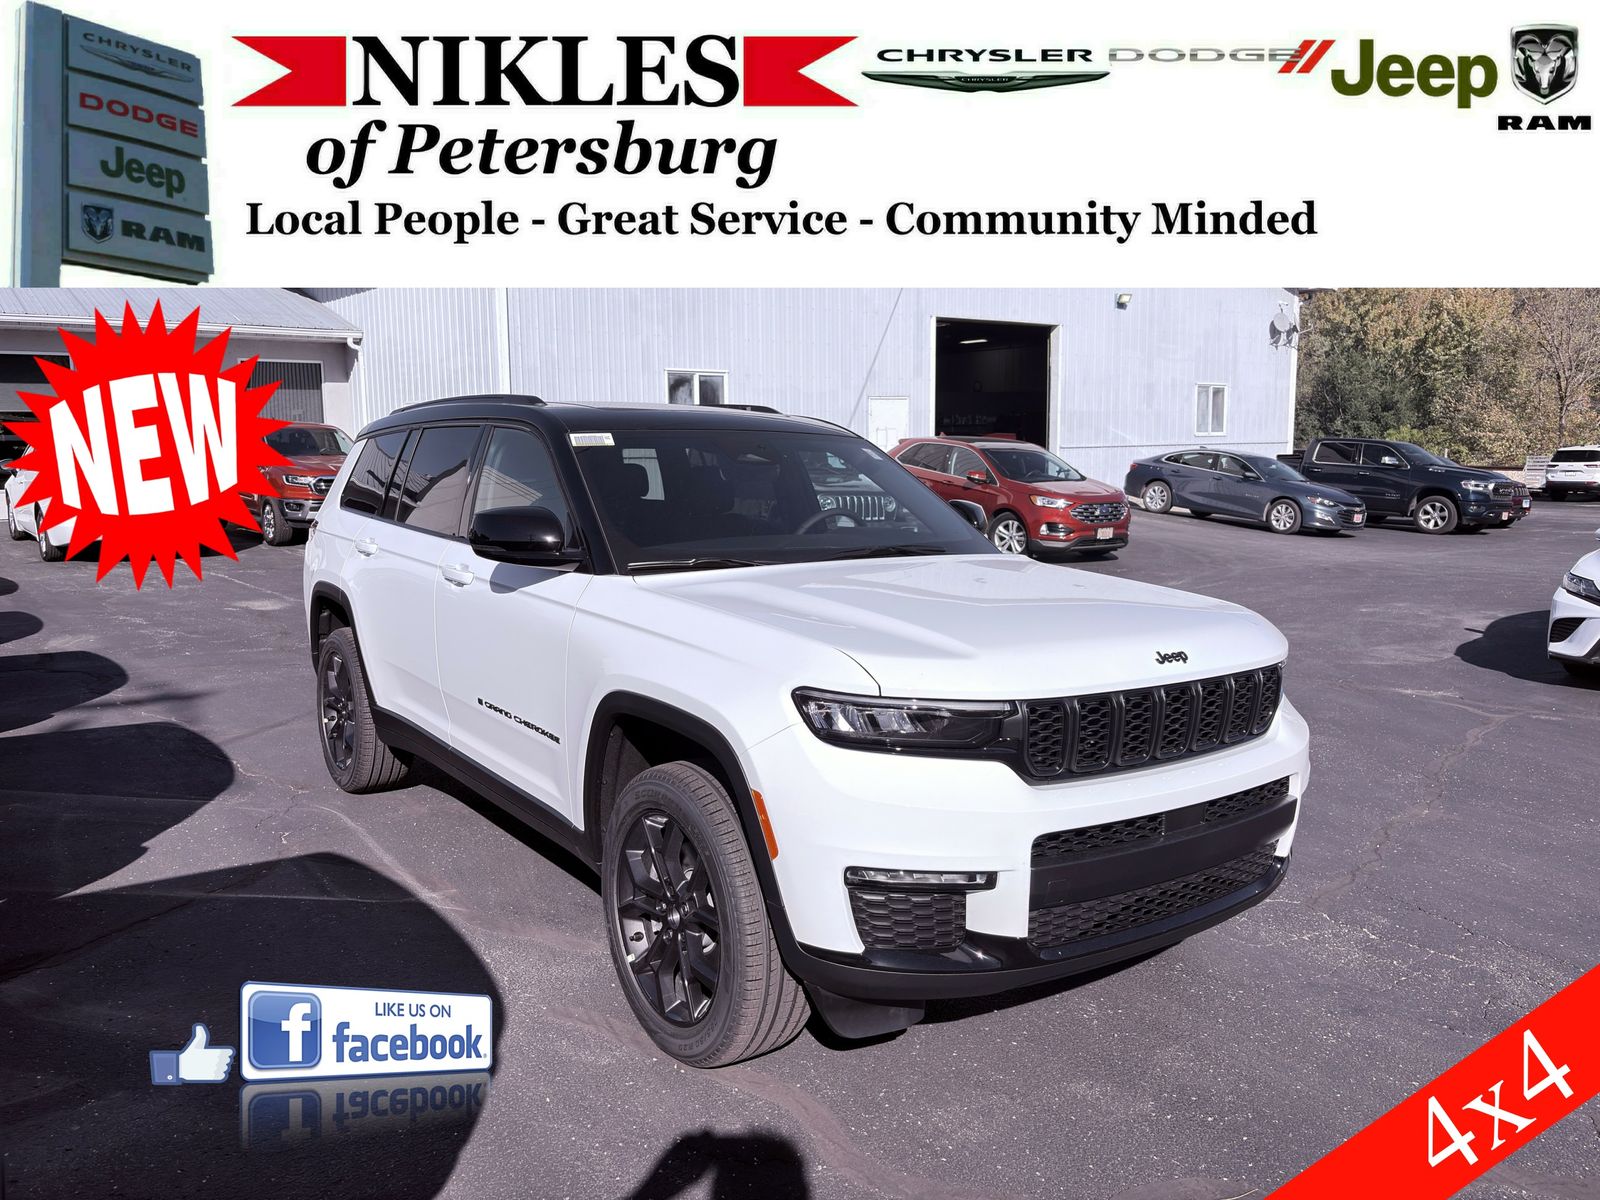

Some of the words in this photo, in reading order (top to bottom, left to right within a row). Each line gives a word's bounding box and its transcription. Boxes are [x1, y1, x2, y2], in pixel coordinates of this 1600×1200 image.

[1155, 651, 1188, 665] Jeep
[484, 701, 512, 719] GRAND
[513, 715, 561, 745] CHEROKEE
